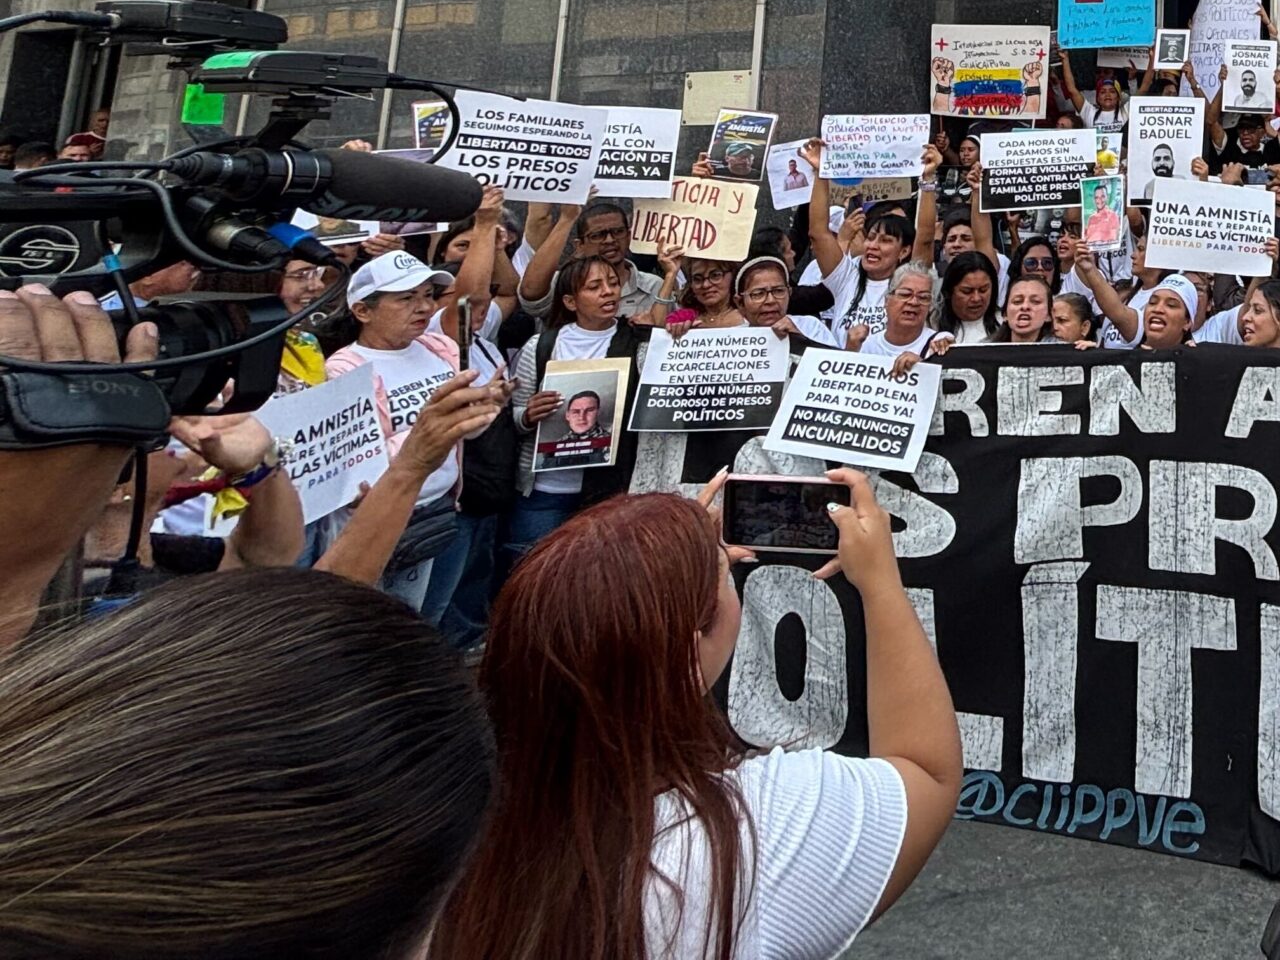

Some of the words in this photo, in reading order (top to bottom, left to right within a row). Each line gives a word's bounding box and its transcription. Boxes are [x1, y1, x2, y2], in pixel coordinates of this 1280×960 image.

[1232, 51, 1269, 59] JOSNAR
[476, 108, 504, 121] LOS
[507, 111, 585, 130] FAMILIARES
[1139, 116, 1193, 127] JOSNAR
[463, 120, 523, 134] SEGUIMOS
[525, 124, 578, 139] ESPERANDO
[581, 131, 592, 140] LA
[727, 123, 766, 134] AMNISTÍA
[827, 125, 887, 134] OBLIGATORIO
[1139, 129, 1193, 139] BADUEL
[458, 136, 526, 152] LIBERTAD
[529, 141, 546, 153] DE
[549, 144, 590, 158] TODOS
[620, 138, 655, 149] CON
[998, 139, 1024, 149] CADA
[1026, 138, 1054, 148] HORA
[1056, 137, 1078, 147] QUE
[652, 152, 670, 164] DE
[826, 152, 869, 160] LIBERTAD
[1005, 148, 1049, 158] PASAMOS
[1052, 146, 1070, 155] SIN
[458, 153, 503, 168] LOS
[507, 157, 578, 175] PRESOS
[823, 161, 849, 170] JUAN
[854, 160, 877, 169] PABLO
[988, 156, 1046, 168] RESPUESTAS
[1049, 155, 1061, 164] ES
[1063, 154, 1085, 163] UNA
[641, 166, 661, 177] YA
[989, 167, 1023, 176] FORMA
[1025, 166, 1038, 175] DE
[1039, 164, 1088, 174] VIOLENCIA
[989, 176, 1029, 186] ESTATAL
[1030, 174, 1068, 184] CONTRA
[1069, 172, 1087, 181] LAS
[671, 180, 720, 207] TICIA
[990, 185, 1033, 195] FAMILIAS
[1035, 183, 1048, 192] DE
[1014, 192, 1062, 203] POLÍTICOS
[1155, 202, 1190, 216] UNA
[1192, 205, 1272, 226] AMNISTÍA
[633, 211, 717, 251] LIBERTAD
[1154, 215, 1176, 225] QUE
[1178, 217, 1213, 228] LIBERE
[1226, 223, 1263, 233] REPARE
[1153, 225, 1194, 238] TODAS
[1195, 228, 1223, 240] LAS
[1152, 239, 1202, 249] LIBERTAD
[1206, 243, 1233, 252] PARA
[672, 339, 688, 348] NO
[691, 338, 713, 348] HAY
[715, 335, 767, 346] NÚMERO
[667, 349, 747, 360] SIGNIFICATIVO
[751, 349, 768, 358] DE
[660, 360, 770, 372] EXCARCELACIONES
[669, 375, 685, 384] EN
[688, 373, 754, 383] VENEZUELA
[817, 360, 919, 387] QUEREMOS
[425, 378, 434, 386] A
[650, 386, 684, 397] PERO
[686, 384, 697, 396] SÍ
[699, 386, 716, 396] UN
[718, 383, 771, 395] NÚMERO
[810, 377, 872, 395] LIBERTAD
[874, 385, 918, 404] PLENA
[389, 394, 420, 413] LOS
[647, 398, 709, 408] DOLOROSO
[711, 398, 726, 407] DE
[728, 396, 772, 406] PRESOS
[805, 391, 840, 405] PARA
[844, 396, 889, 413] TODOS
[892, 403, 914, 418] YA!
[294, 397, 373, 444] AMNISTÍA
[672, 407, 745, 422] POLÍTICOS
[794, 409, 813, 421] NO
[815, 410, 842, 426] MÁS
[842, 415, 910, 438] ANUNCIOS
[319, 439, 327, 450] Y
[329, 421, 365, 445] REPARE
[368, 416, 377, 426] A
[788, 423, 903, 455] INCUMPLIDOS
[290, 457, 321, 480] LAS
[323, 428, 380, 466] VÍCTIMAS
[308, 467, 340, 489] PARA
[341, 445, 383, 470] TODOS
